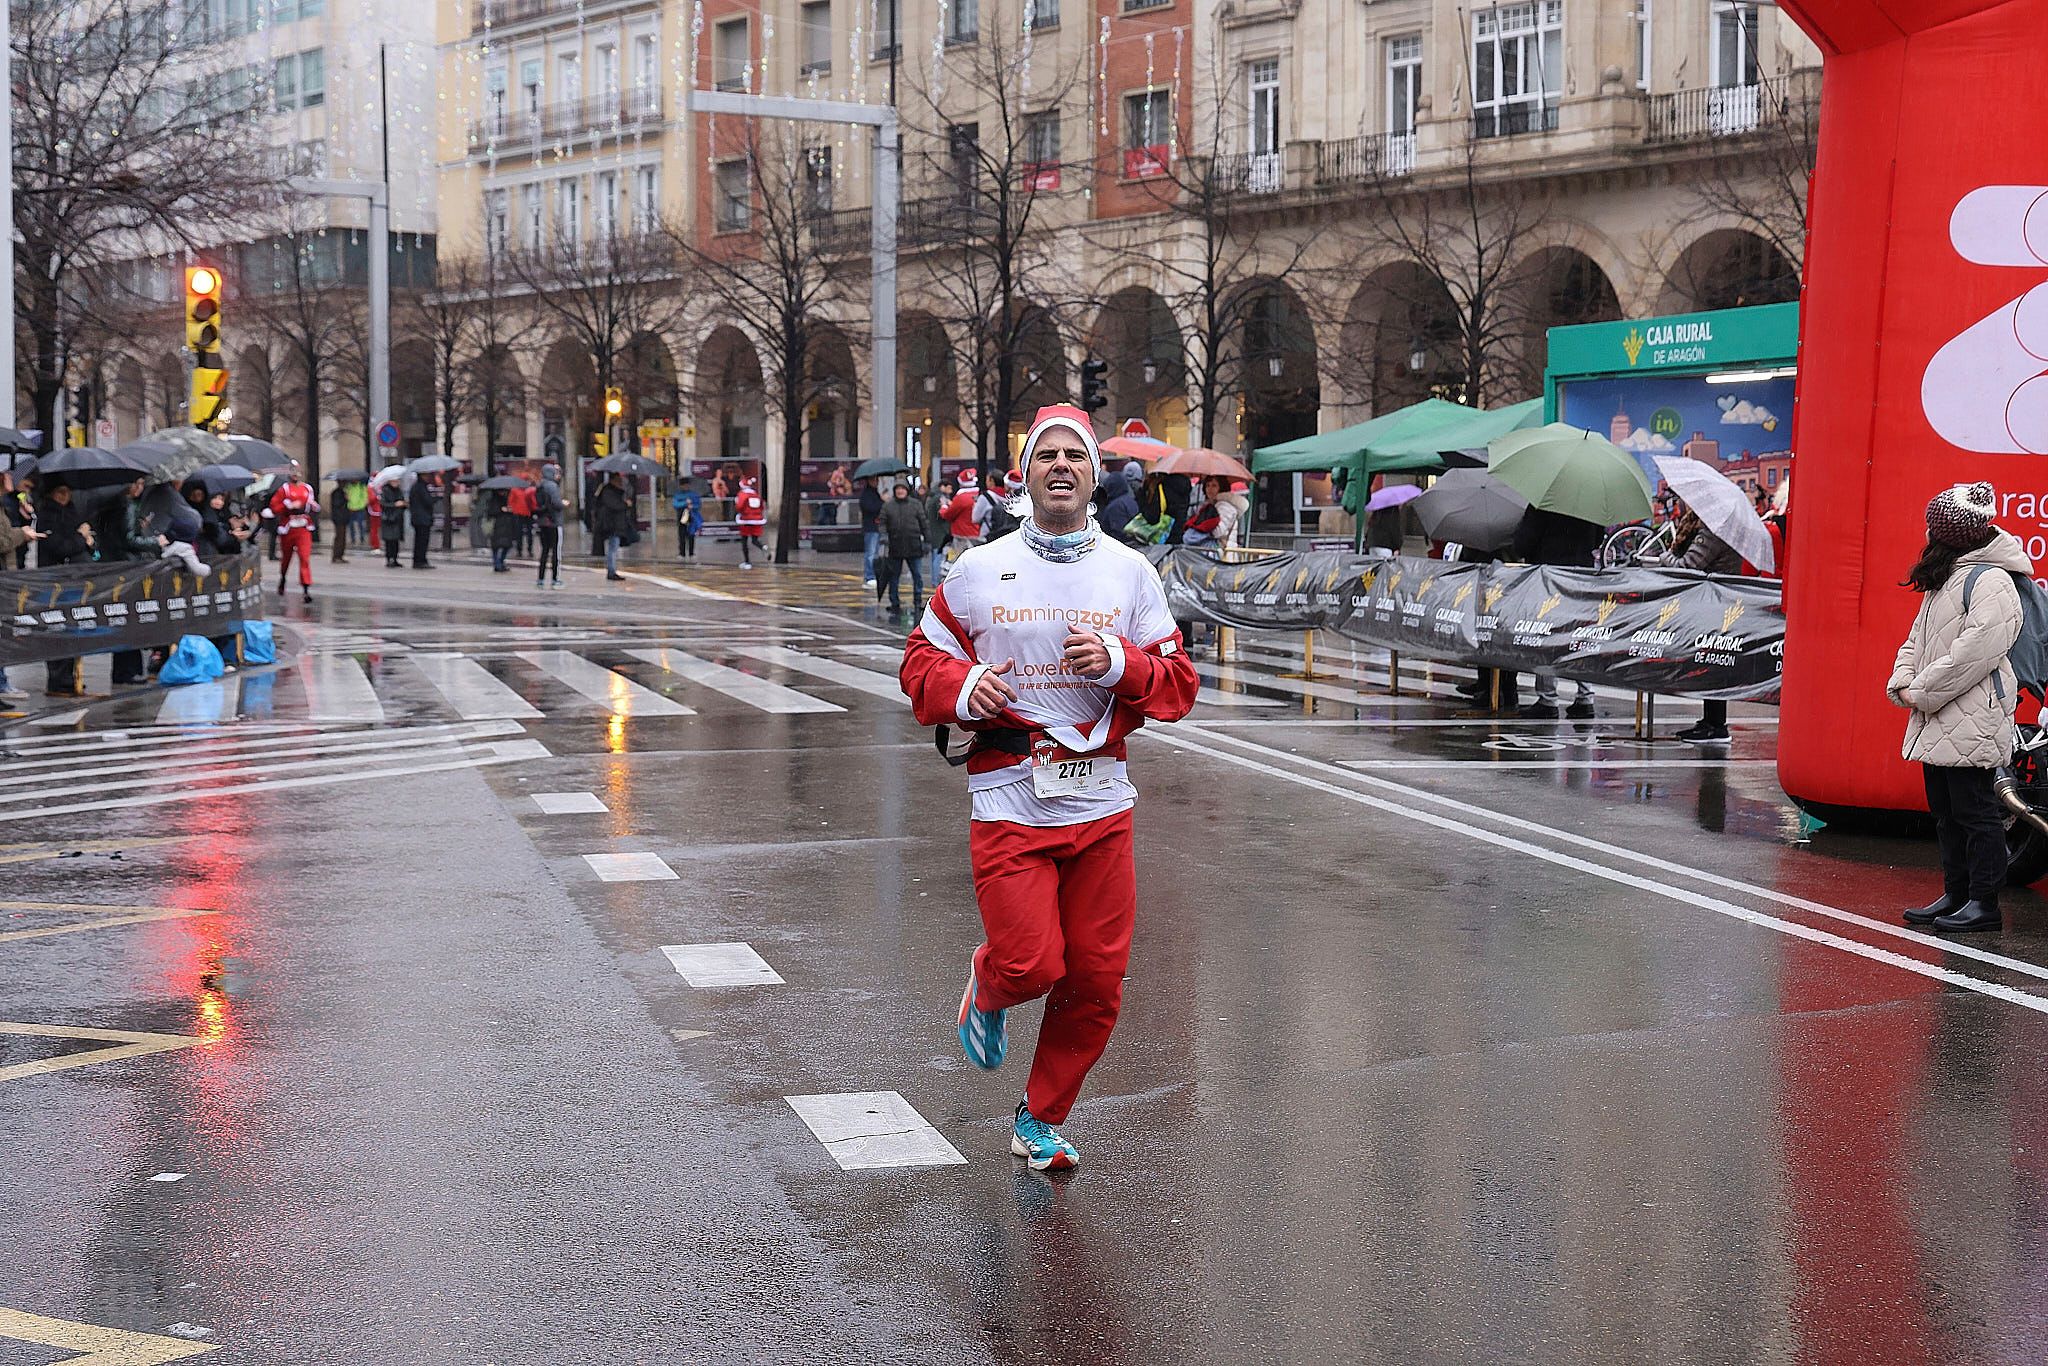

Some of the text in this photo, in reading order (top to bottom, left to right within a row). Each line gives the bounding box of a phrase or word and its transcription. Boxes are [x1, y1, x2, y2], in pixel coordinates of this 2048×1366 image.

[1646, 321, 1713, 346] CAJA RURAL
[1653, 343, 1706, 364] DE ARAGÓN
[1655, 414, 1678, 433] in
[1695, 633, 1744, 651] CAJA RURAL
[1694, 652, 1736, 667] DE ARAGÓN
[1058, 759, 1094, 779] 2721
